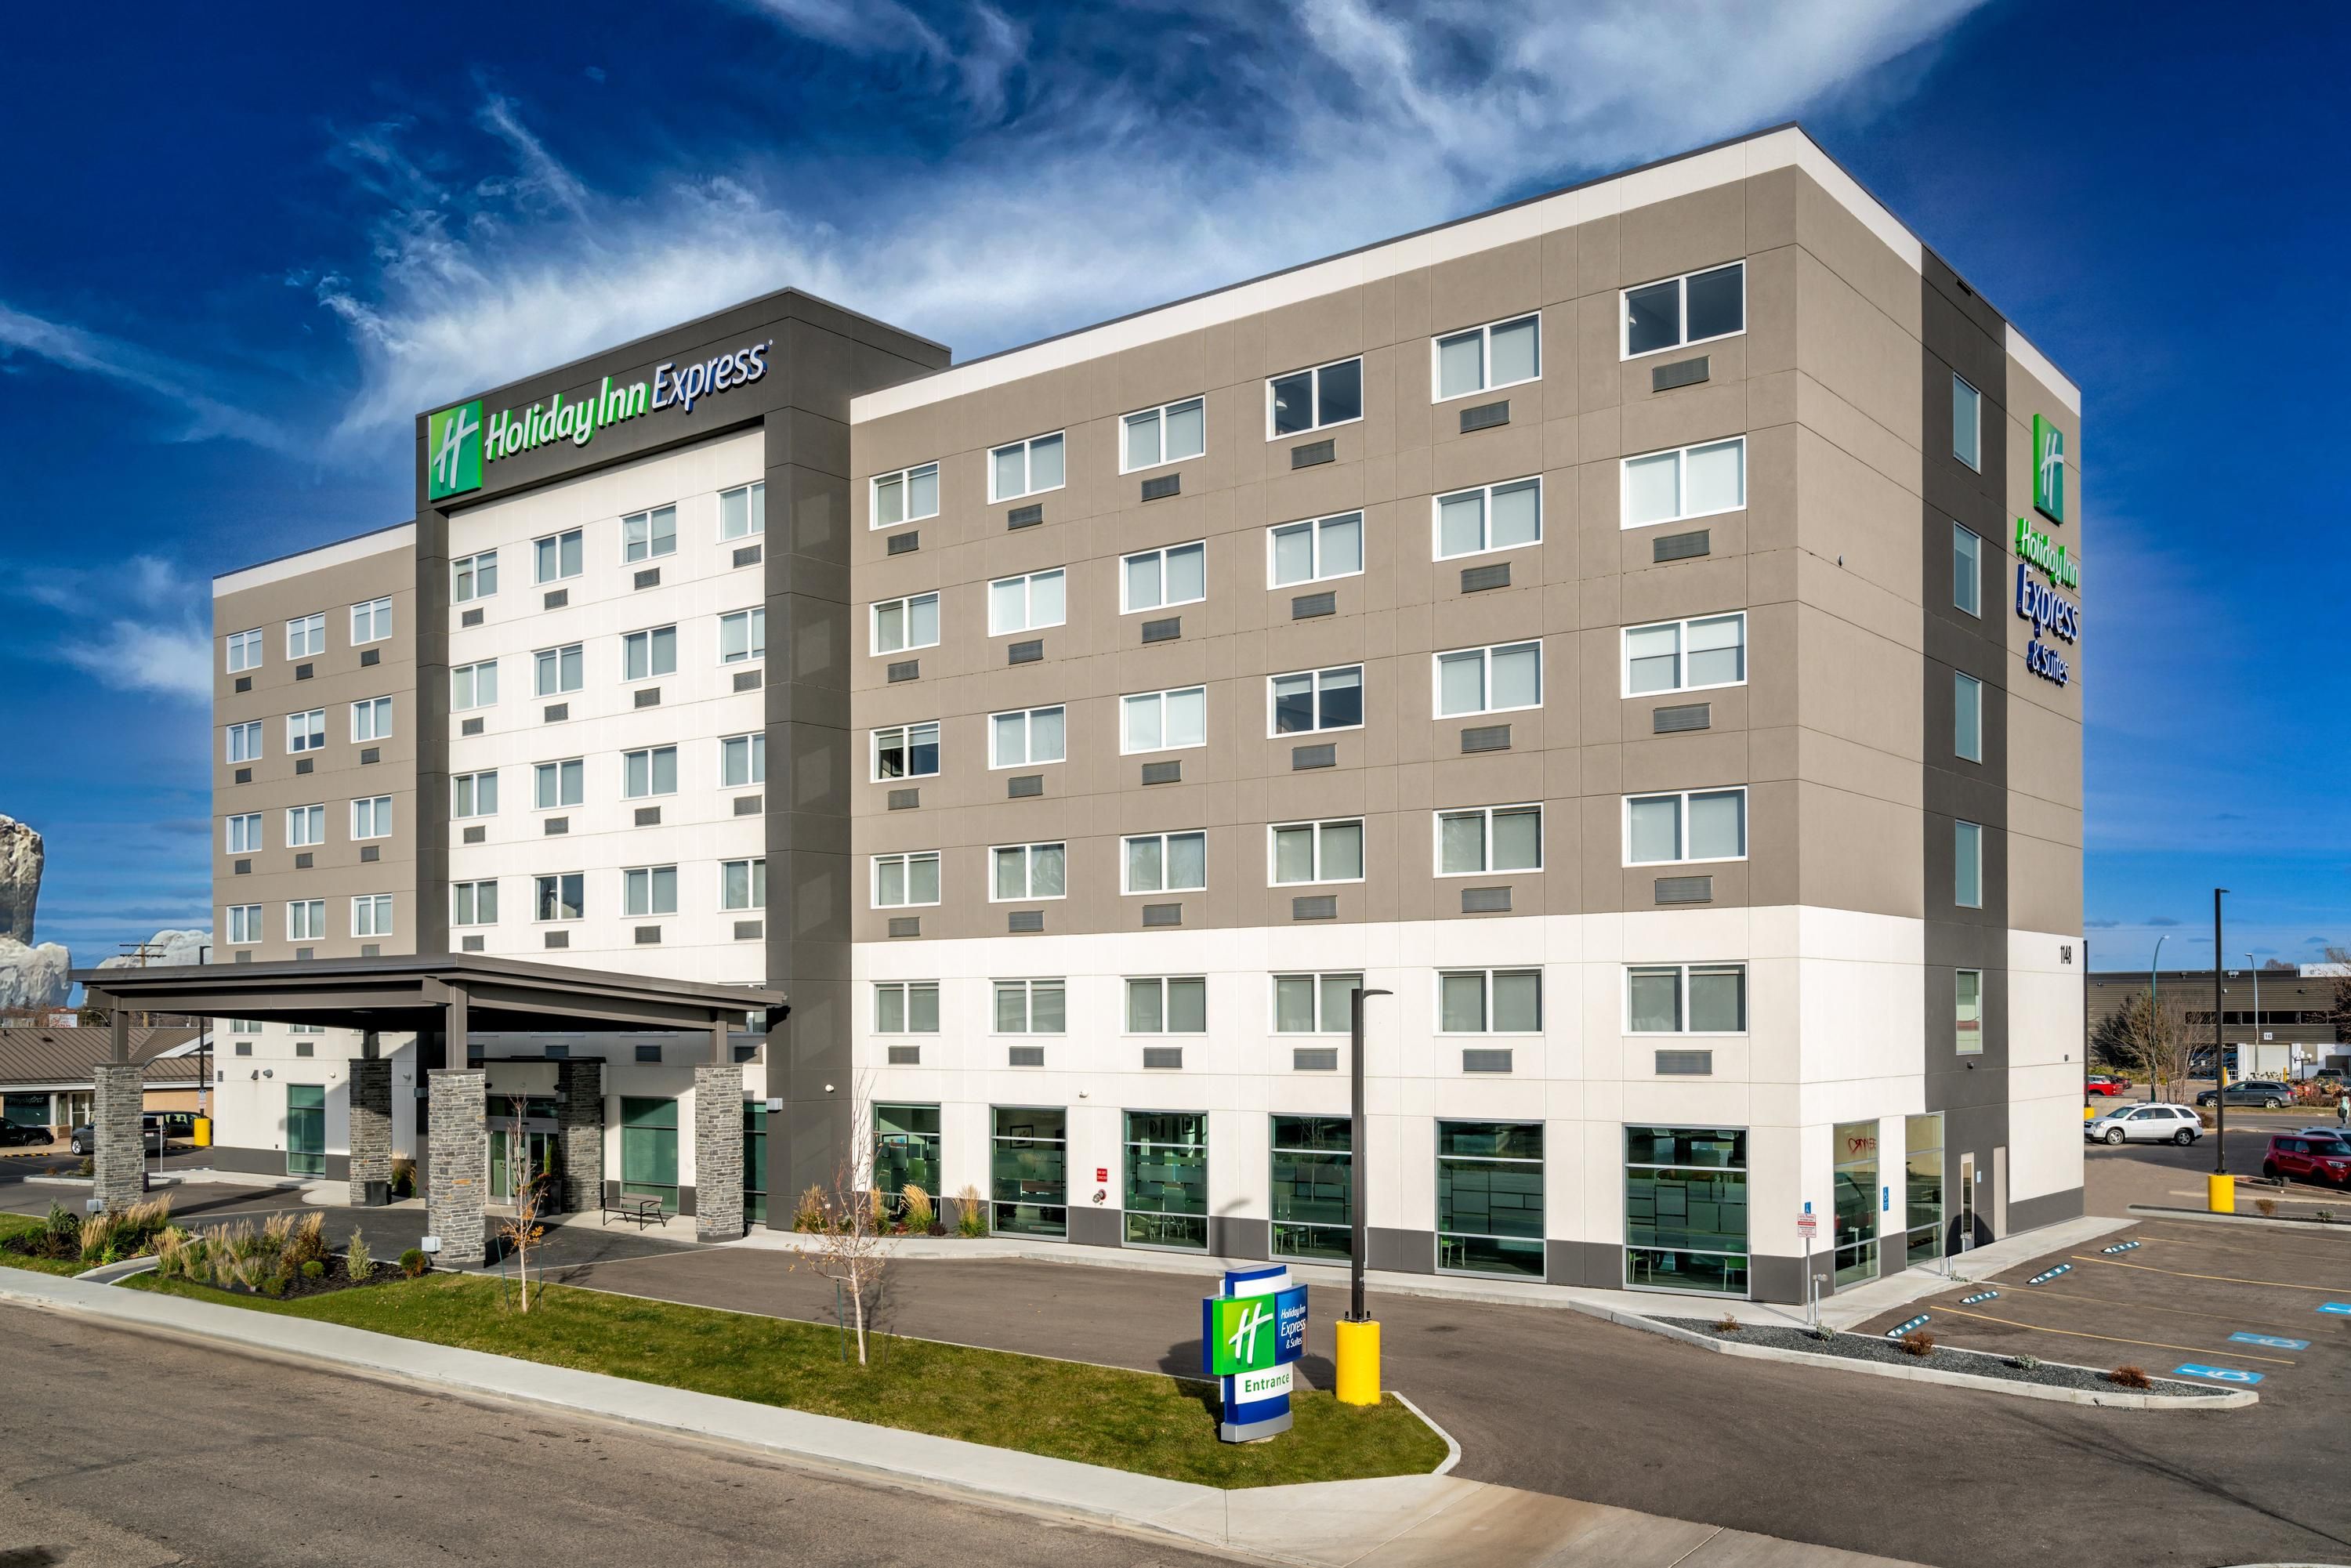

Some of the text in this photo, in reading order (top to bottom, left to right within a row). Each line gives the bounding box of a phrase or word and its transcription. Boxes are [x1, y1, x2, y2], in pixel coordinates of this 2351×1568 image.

[484, 344, 768, 462] Holiday Inn Express
[2019, 517, 2078, 589] Holiday Inn
[2018, 563, 2079, 642] Express
[2028, 639, 2069, 686] & Suites
[2060, 945, 2072, 965] 1148
[1281, 1306, 1299, 1320] Holiday
[1281, 1319, 1306, 1338] Express
[1286, 1337, 1302, 1349] & Suites
[1244, 1373, 1290, 1392] Entrance
